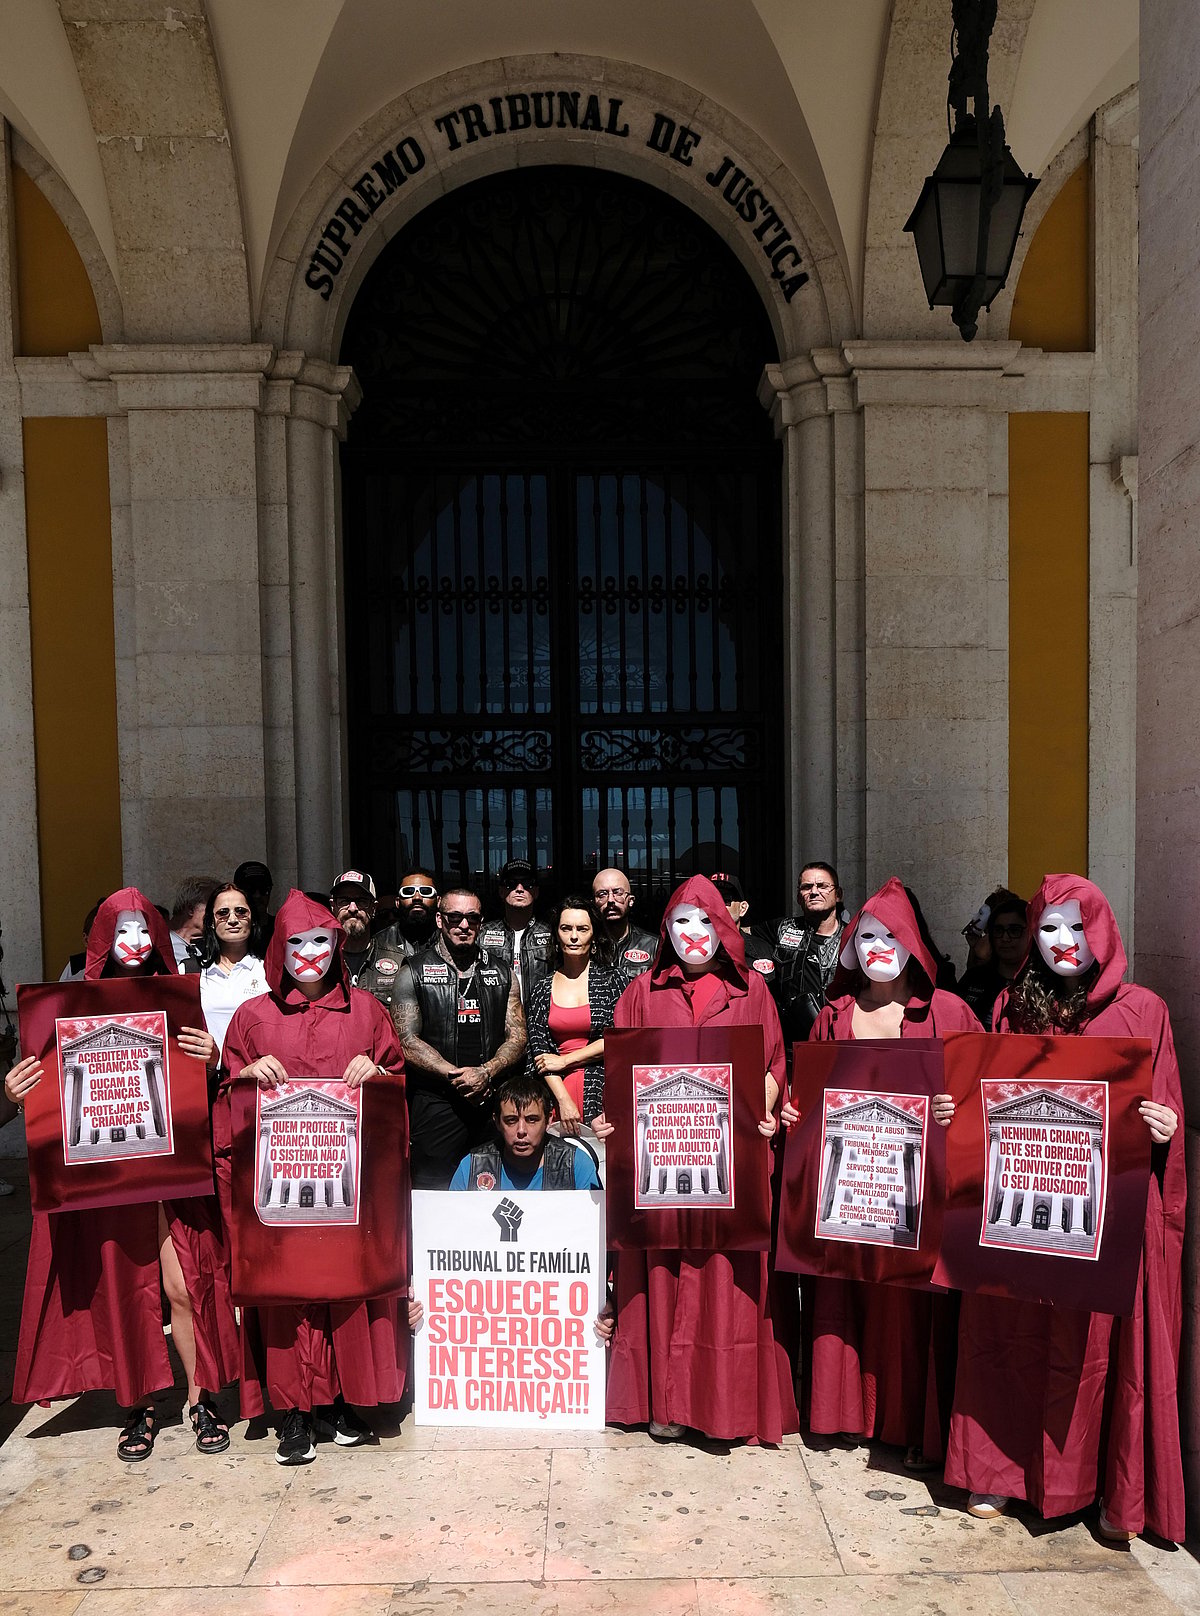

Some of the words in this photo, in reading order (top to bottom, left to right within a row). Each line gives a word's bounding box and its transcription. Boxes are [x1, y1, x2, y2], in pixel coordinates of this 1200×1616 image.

[304, 136, 426, 301] SUPREMO
[435, 91, 629, 151] TRIBUNAL
[646, 113, 702, 166] DE
[705, 156, 810, 303] JUSTIÇA
[78, 1050, 128, 1064] ACREDITEM
[130, 1048, 149, 1059] NAS
[88, 1060, 142, 1075] CRIANÇAS.
[90, 1078, 125, 1091] OUÇAM
[128, 1076, 140, 1086] AS
[90, 1087, 143, 1102] CRIANÇAS.
[83, 1103, 135, 1117] PROTEJAM
[137, 1101, 150, 1111] AS
[649, 1104, 655, 1114] A
[657, 1103, 705, 1115] SEGURANÇA
[707, 1103, 718, 1113] DA
[91, 1113, 145, 1129] CRIANÇAS.
[272, 1121, 297, 1134] QUEM
[300, 1121, 337, 1133] PROTEGE
[339, 1121, 345, 1133] A
[652, 1116, 692, 1129] CRIANÇA
[694, 1114, 715, 1127] ESTÁ
[844, 1122, 874, 1133] DENÚNCIA
[876, 1125, 884, 1133] DE
[885, 1126, 905, 1135] ABUSO
[646, 1129, 674, 1140] ACIMA
[677, 1129, 688, 1140] DO
[690, 1128, 720, 1140] DIREITO
[1001, 1126, 1047, 1142] NENHUMA
[1050, 1130, 1090, 1146] CRIANÇA
[270, 1135, 309, 1149] CRIANÇA
[312, 1135, 346, 1148] QUANDO
[649, 1142, 659, 1153] DE
[662, 1142, 676, 1153] UM
[679, 1141, 710, 1153] ADULTO
[845, 1140, 871, 1149] TRIBUNAL
[872, 1142, 880, 1150] DE
[880, 1142, 903, 1151] FAMÍLIA
[270, 1149, 277, 1161] O
[279, 1150, 318, 1161] SISTEMA
[320, 1147, 338, 1161] NÃO
[339, 1149, 346, 1161] A
[653, 1152, 715, 1166] CONVIVÊNCIA.
[862, 1149, 889, 1157] MENORES
[1000, 1142, 1022, 1156] DEVE
[1025, 1144, 1042, 1158] SER
[1044, 1145, 1092, 1162] OBRIGADA
[273, 1163, 342, 1179] PROTEGE?
[846, 1163, 874, 1173] SERVIÇOS
[876, 1165, 898, 1174] SOCIAIS
[1004, 1158, 1011, 1172] A
[1013, 1159, 1062, 1176] CONVIVER
[1064, 1163, 1087, 1179] COM
[838, 1179, 874, 1189] PROGENITOR
[875, 1183, 904, 1192] PROTETOR
[1002, 1174, 1008, 1188] O
[1011, 1175, 1030, 1191] SEU
[1032, 1177, 1090, 1196] ABUSADOR.
[853, 1189, 888, 1198] PENALIZADO
[839, 1212, 866, 1221] RETOMAR
[840, 1204, 865, 1214] CRIANÇA
[866, 1207, 895, 1216] OBRIGADA
[427, 1249, 502, 1273] TRIBUNAL
[507, 1251, 525, 1273] DE
[530, 1248, 591, 1274] FAMÍLIA
[428, 1279, 559, 1316] ESQUECE
[569, 1281, 589, 1316] O
[428, 1314, 585, 1348] SUPERIOR
[428, 1345, 589, 1380] INTERESSE
[428, 1378, 459, 1410] DA
[465, 1379, 590, 1419] CRIANÇA!!!
